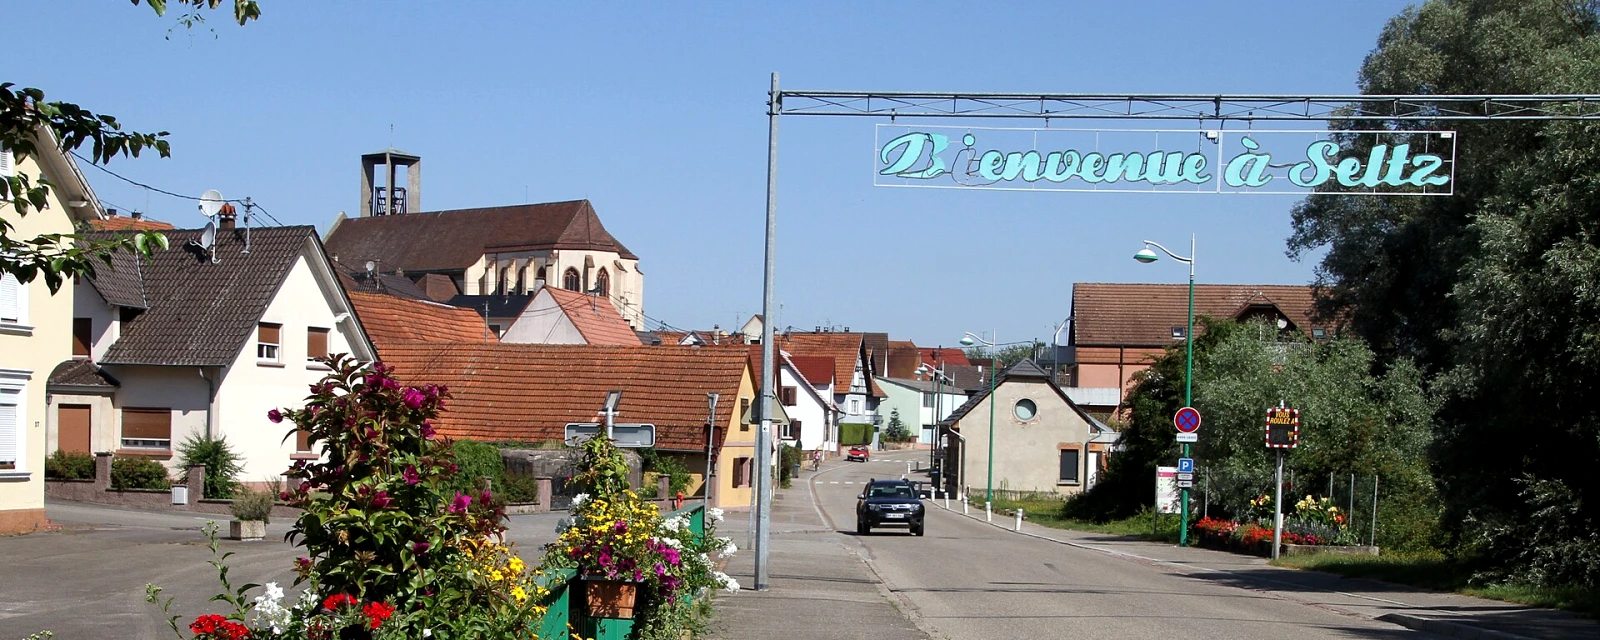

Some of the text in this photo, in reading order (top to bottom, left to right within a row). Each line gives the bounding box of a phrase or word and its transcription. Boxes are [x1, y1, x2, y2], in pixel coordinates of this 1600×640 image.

[879, 131, 1450, 187] Bienvenue à Seltz
[1270, 417, 1290, 425] ROULEZ
[1182, 461, 1189, 470] P
